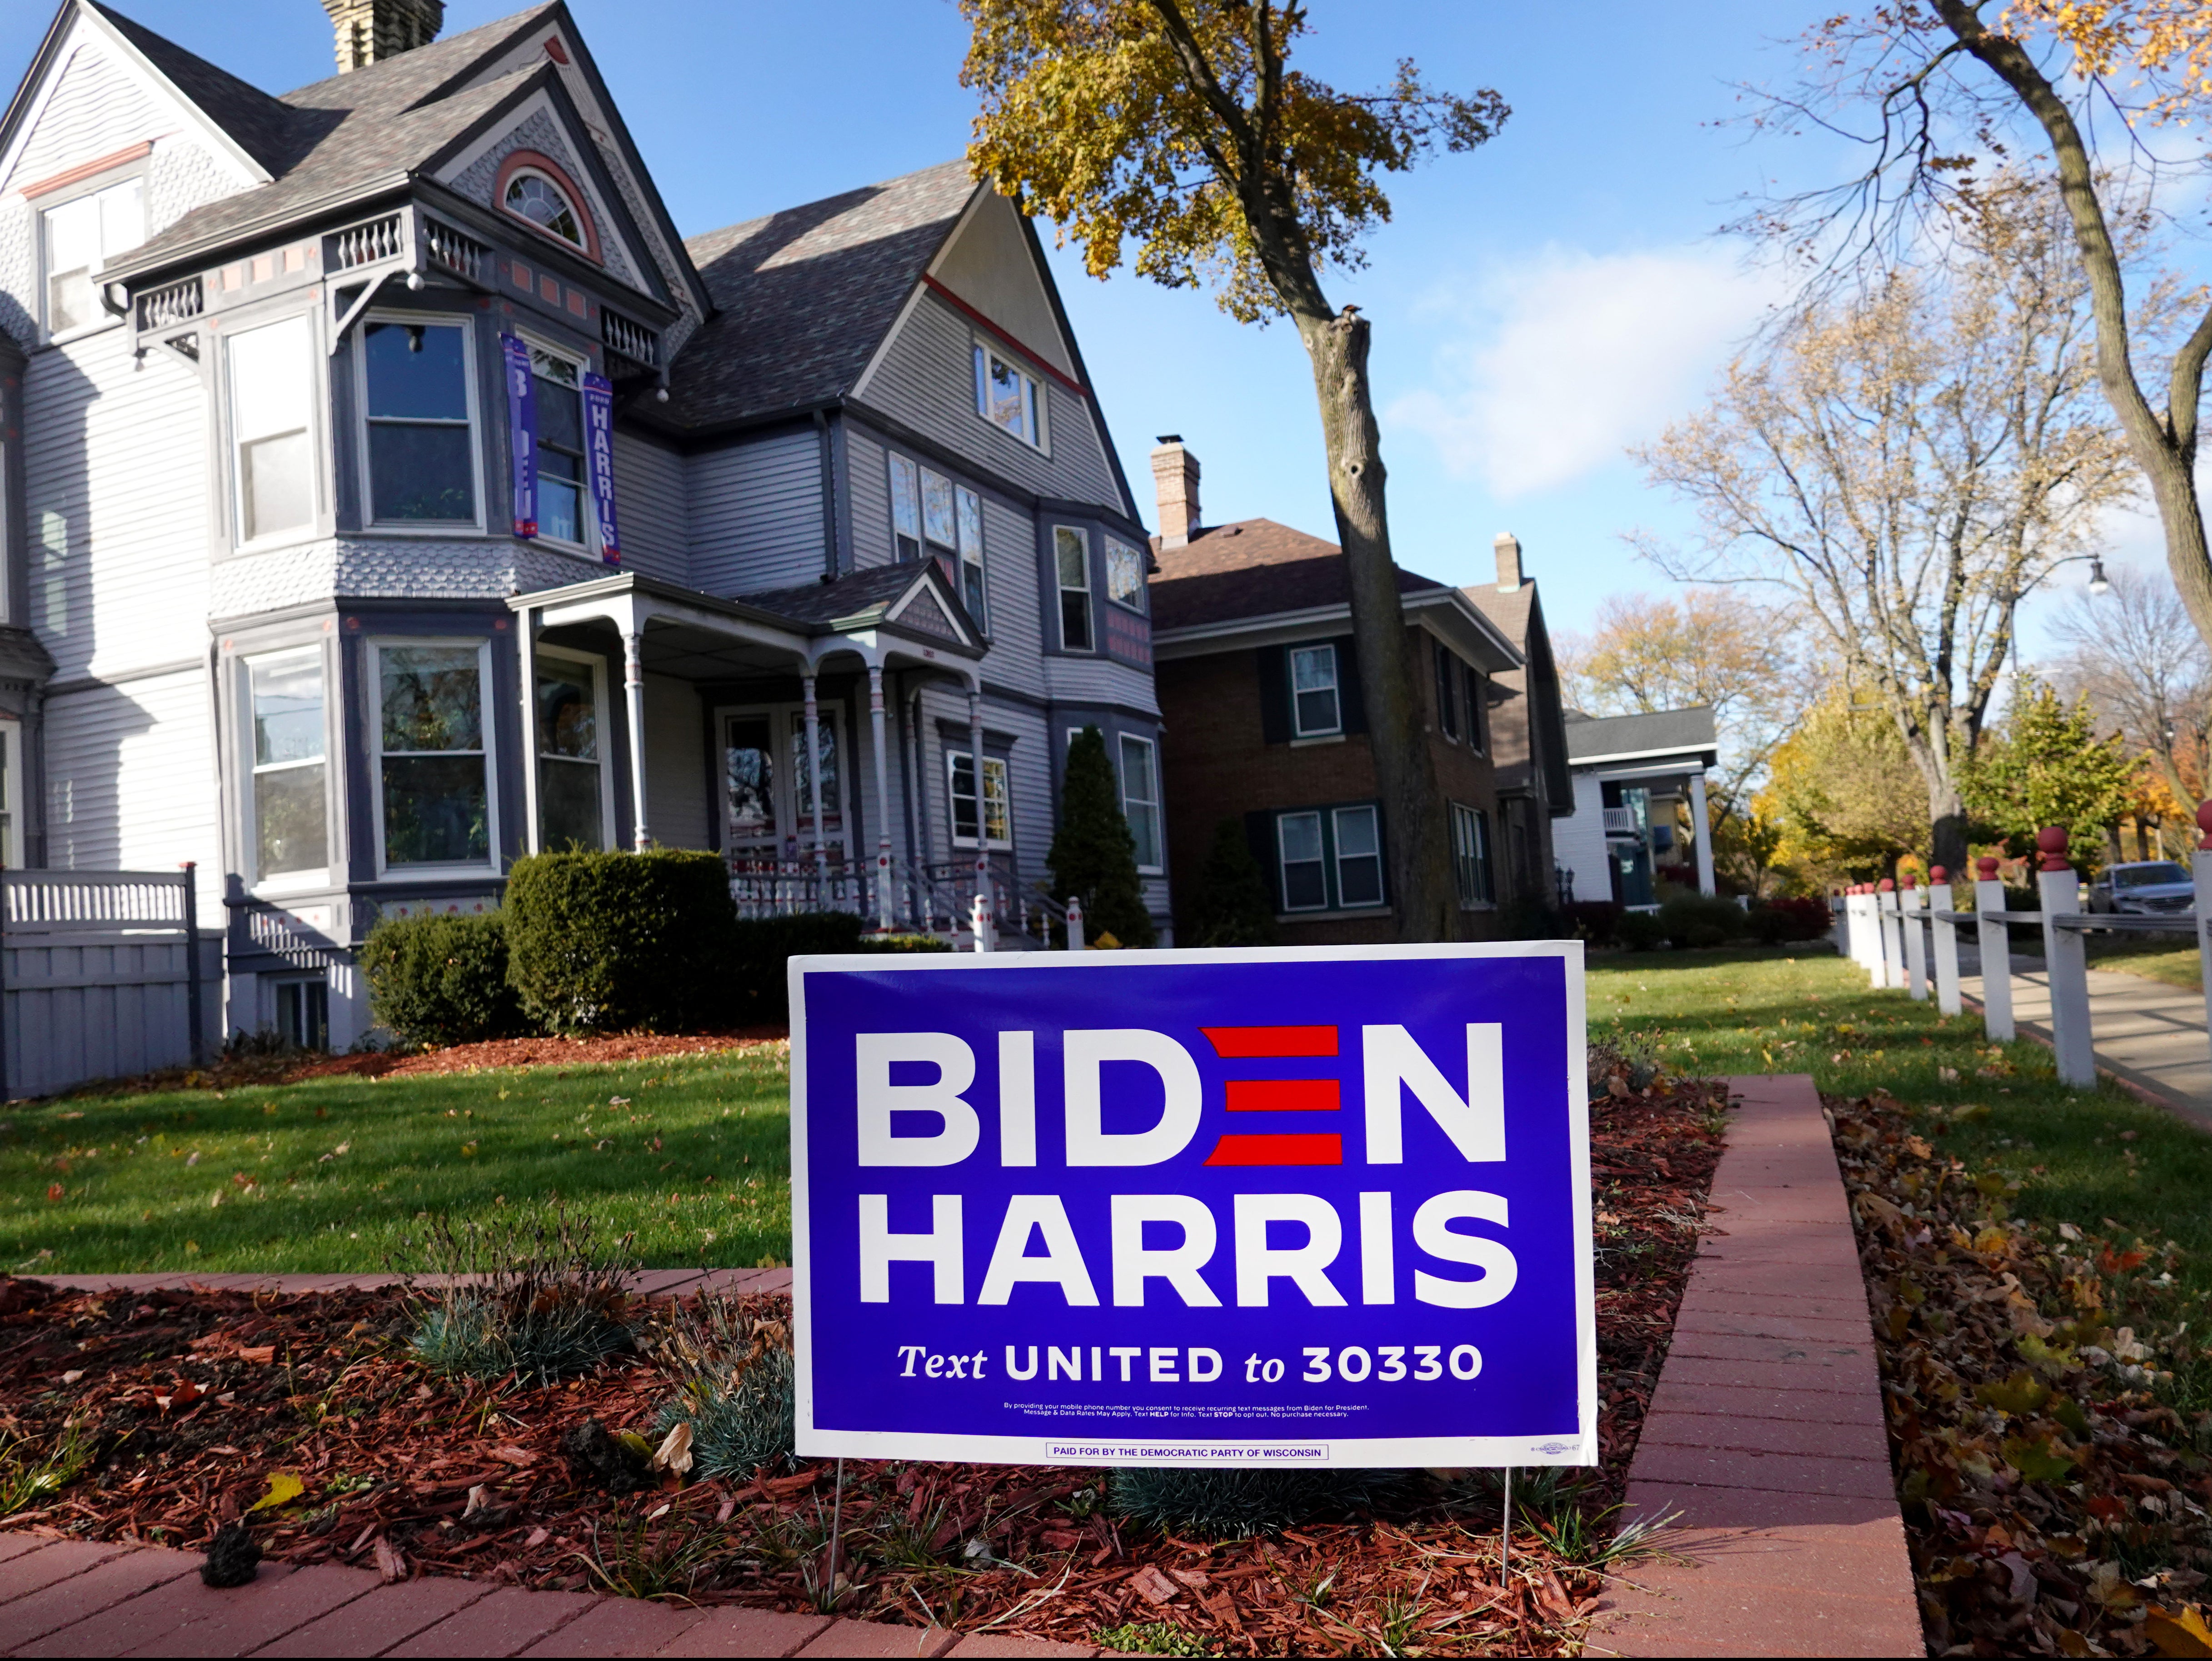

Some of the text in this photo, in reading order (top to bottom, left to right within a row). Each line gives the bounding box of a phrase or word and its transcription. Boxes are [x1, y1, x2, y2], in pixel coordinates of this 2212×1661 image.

[592, 404, 615, 546] HARRIS
[856, 1023, 1506, 1167] BIDEN
[859, 1190, 1518, 1309] HARRIS
[898, 1344, 1483, 1383] Text UNITED to 30330
[1054, 1447, 1077, 1455] PAID
[1103, 1448, 1116, 1456] BY
[1141, 1448, 1208, 1456] DEMOCRATIC
[1263, 1449, 1321, 1457] WISCONSIN
